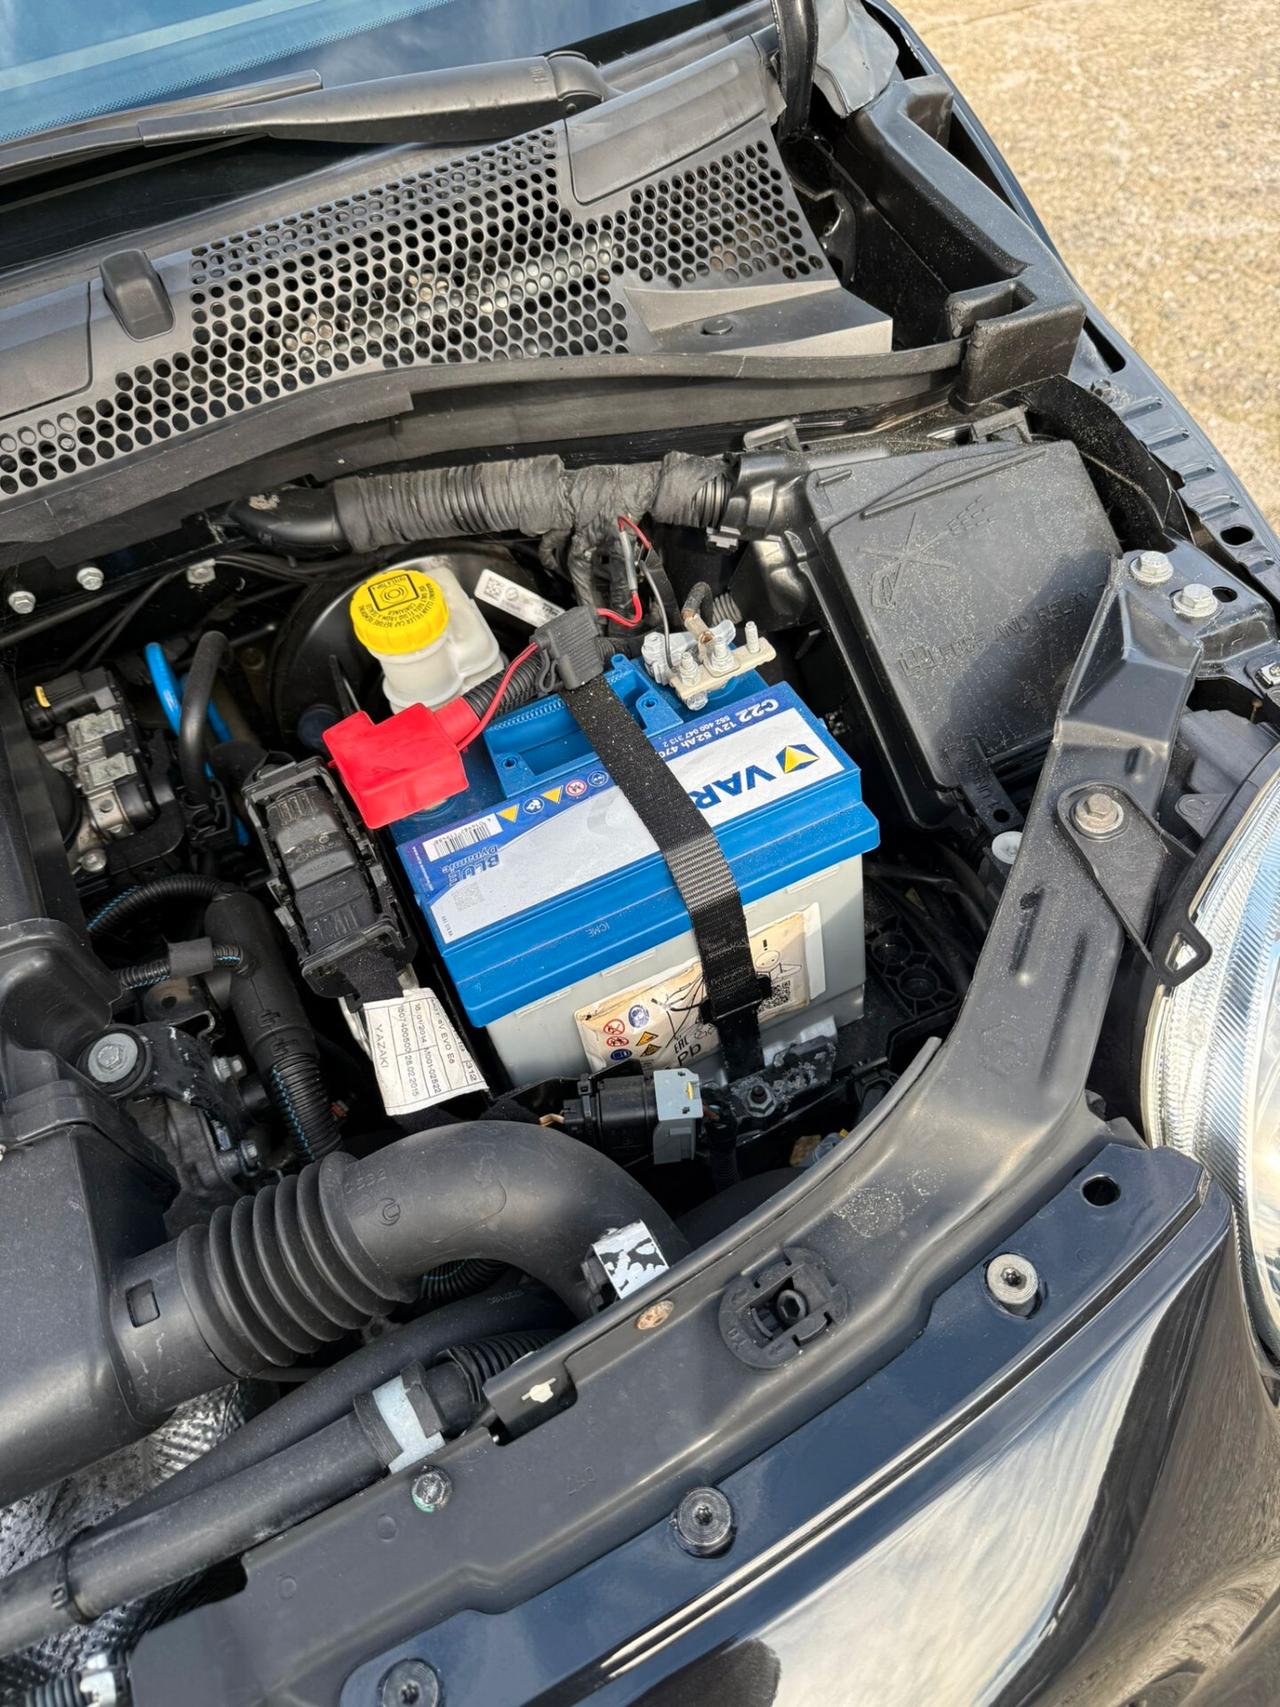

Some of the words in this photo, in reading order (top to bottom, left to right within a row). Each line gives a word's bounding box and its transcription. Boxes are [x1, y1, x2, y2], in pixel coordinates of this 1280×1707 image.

[994, 614, 1030, 642] AND
[735, 698, 779, 723] C22
[681, 731, 712, 748] 52Ah
[715, 721, 737, 735] 12V
[656, 745, 679, 758] 470
[689, 764, 776, 809] VAR
[448, 854, 500, 886] BLUE
[374, 1023, 389, 1068] YAZAKI
[677, 1043, 701, 1066] Pb
